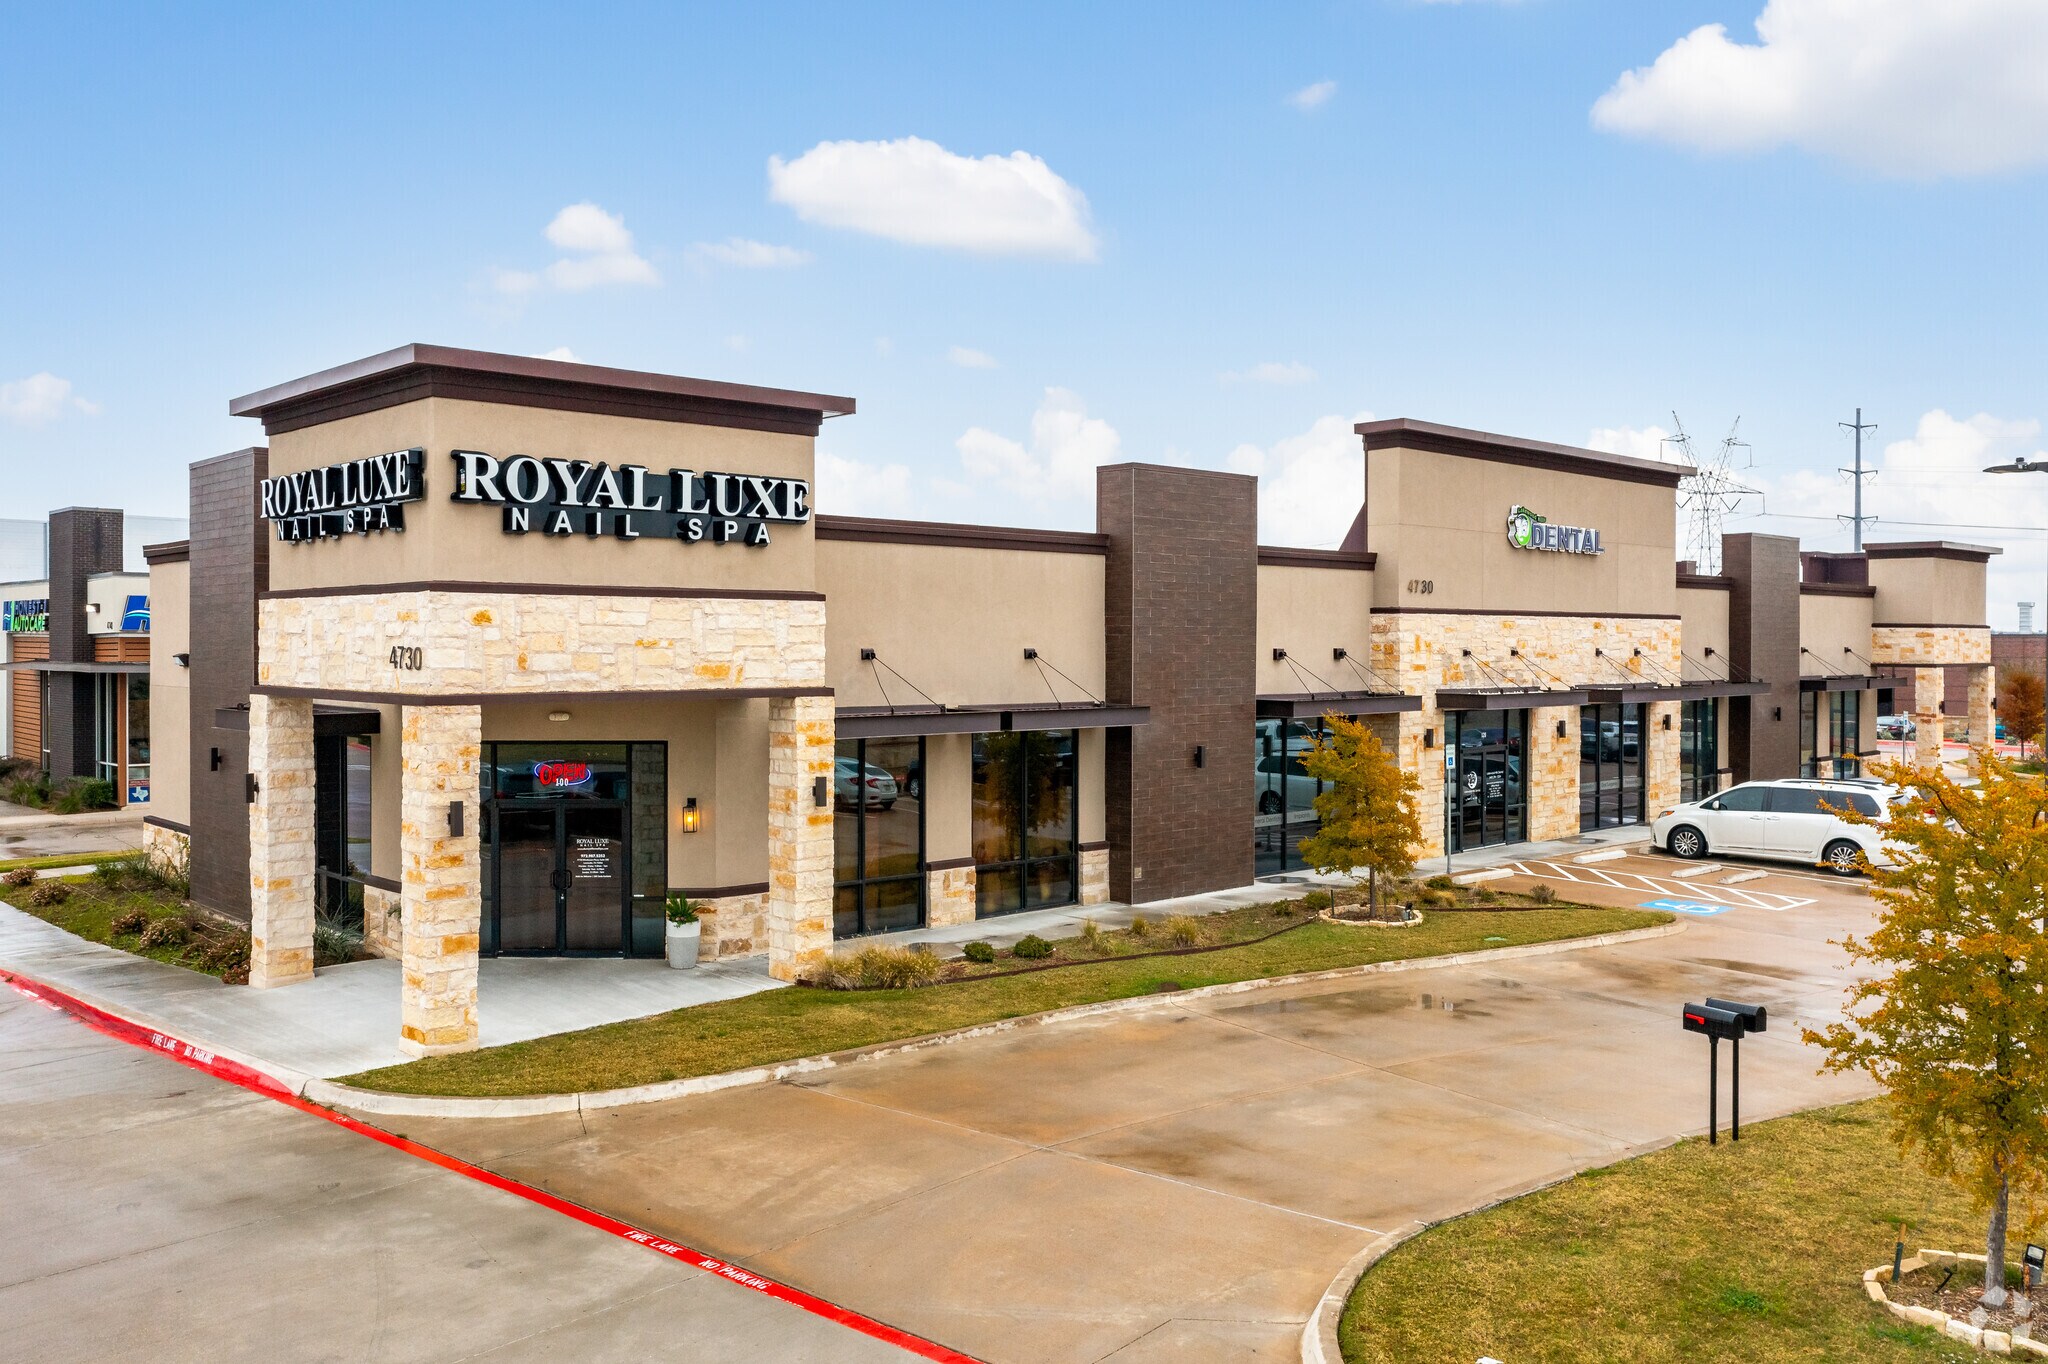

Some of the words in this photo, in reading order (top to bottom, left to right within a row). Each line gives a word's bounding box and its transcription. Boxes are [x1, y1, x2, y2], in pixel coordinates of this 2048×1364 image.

[260, 467, 336, 519] ROYAL
[340, 450, 411, 506] LUXE
[458, 453, 662, 512] ROYAL
[677, 471, 811, 521] LUXE
[277, 514, 326, 540] NAIL
[347, 505, 389, 533] SPA
[511, 508, 639, 536] NAIL
[688, 518, 771, 544] SPA
[1531, 523, 1605, 554] DENTAL
[1407, 579, 1434, 595] 4730
[13, 614, 29, 631] AUTO
[30, 613, 46, 631] CARE
[389, 645, 423, 671] 4730
[540, 763, 586, 785] OPEN
[555, 778, 569, 787] 100
[152, 1033, 164, 1047] FIRE
[163, 1037, 177, 1051] LANE
[184, 1045, 193, 1057] NO
[624, 1230, 653, 1243] FIRE
[649, 1240, 684, 1255] LANE
[699, 1259, 721, 1274] NO
[719, 1265, 772, 1290] PARKING
